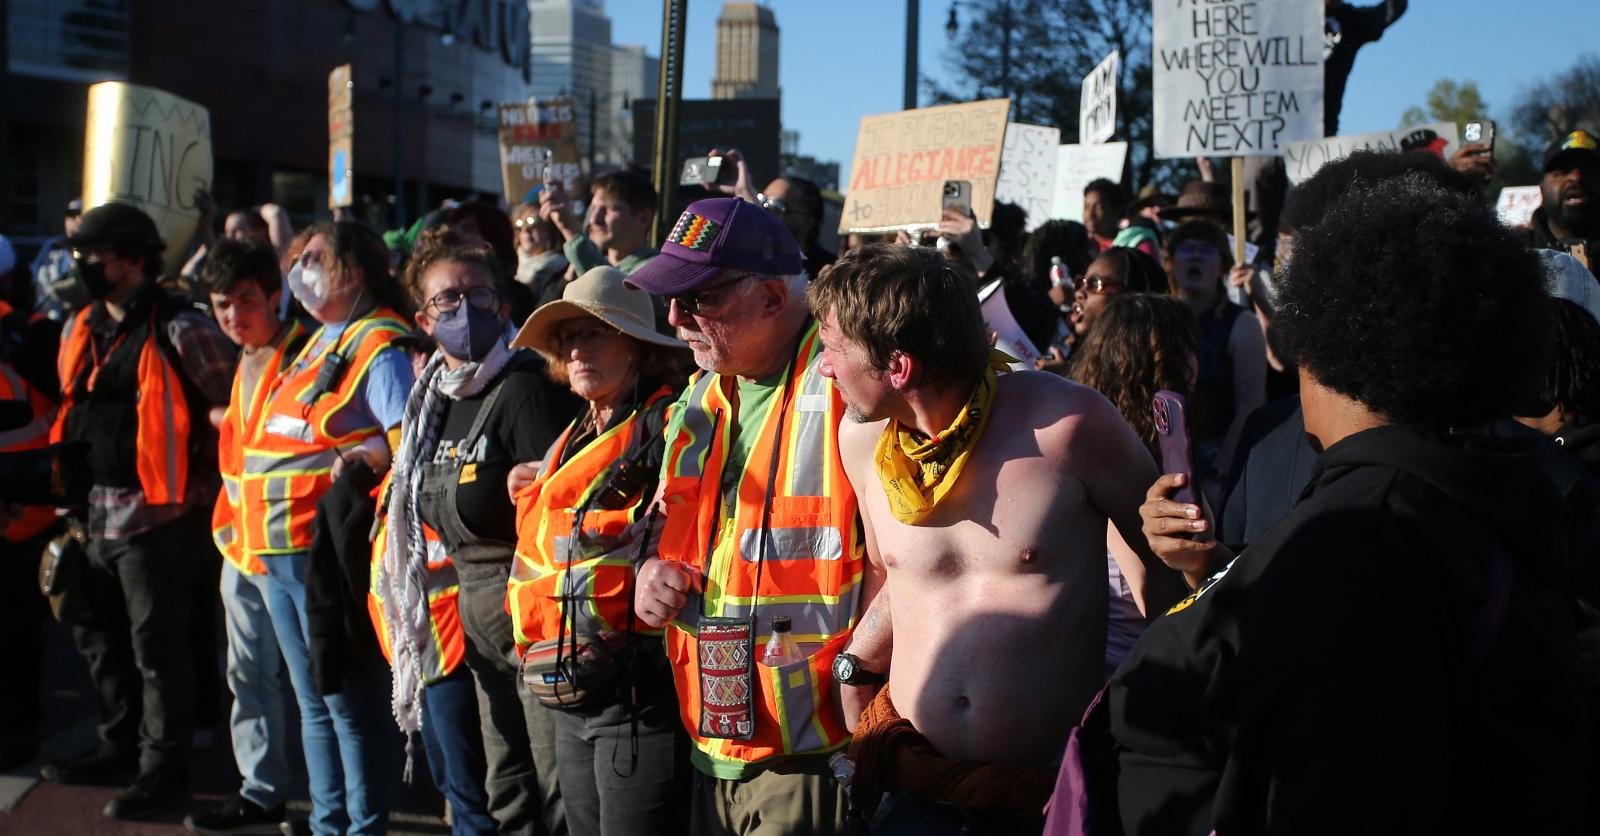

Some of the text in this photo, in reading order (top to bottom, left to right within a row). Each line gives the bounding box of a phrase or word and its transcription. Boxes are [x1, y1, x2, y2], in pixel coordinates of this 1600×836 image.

[1192, 3, 1258, 38] HERE
[1161, 35, 1318, 70] WHERE WILL
[1197, 67, 1260, 96] YOU
[1184, 90, 1300, 121] MEET EM
[1186, 116, 1286, 152] NEXT?
[852, 144, 997, 191] ALLEGIANCE
